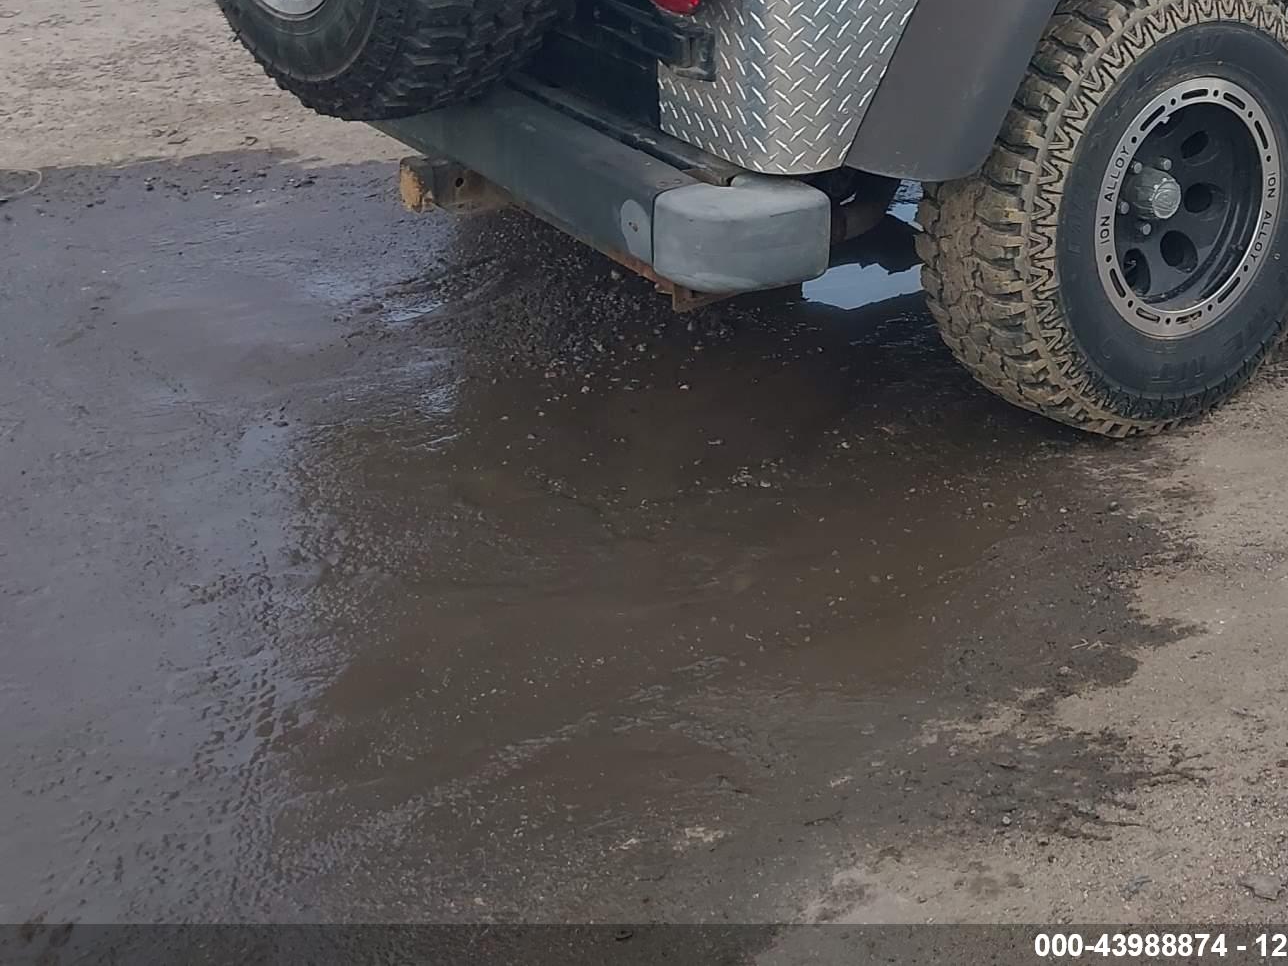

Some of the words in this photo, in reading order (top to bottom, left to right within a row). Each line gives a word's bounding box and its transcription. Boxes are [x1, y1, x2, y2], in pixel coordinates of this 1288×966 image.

[1104, 145, 1129, 202] ALLOY
[1267, 172, 1277, 198] ION
[1100, 216, 1111, 245] ION
[1250, 210, 1273, 262] ALLOY
